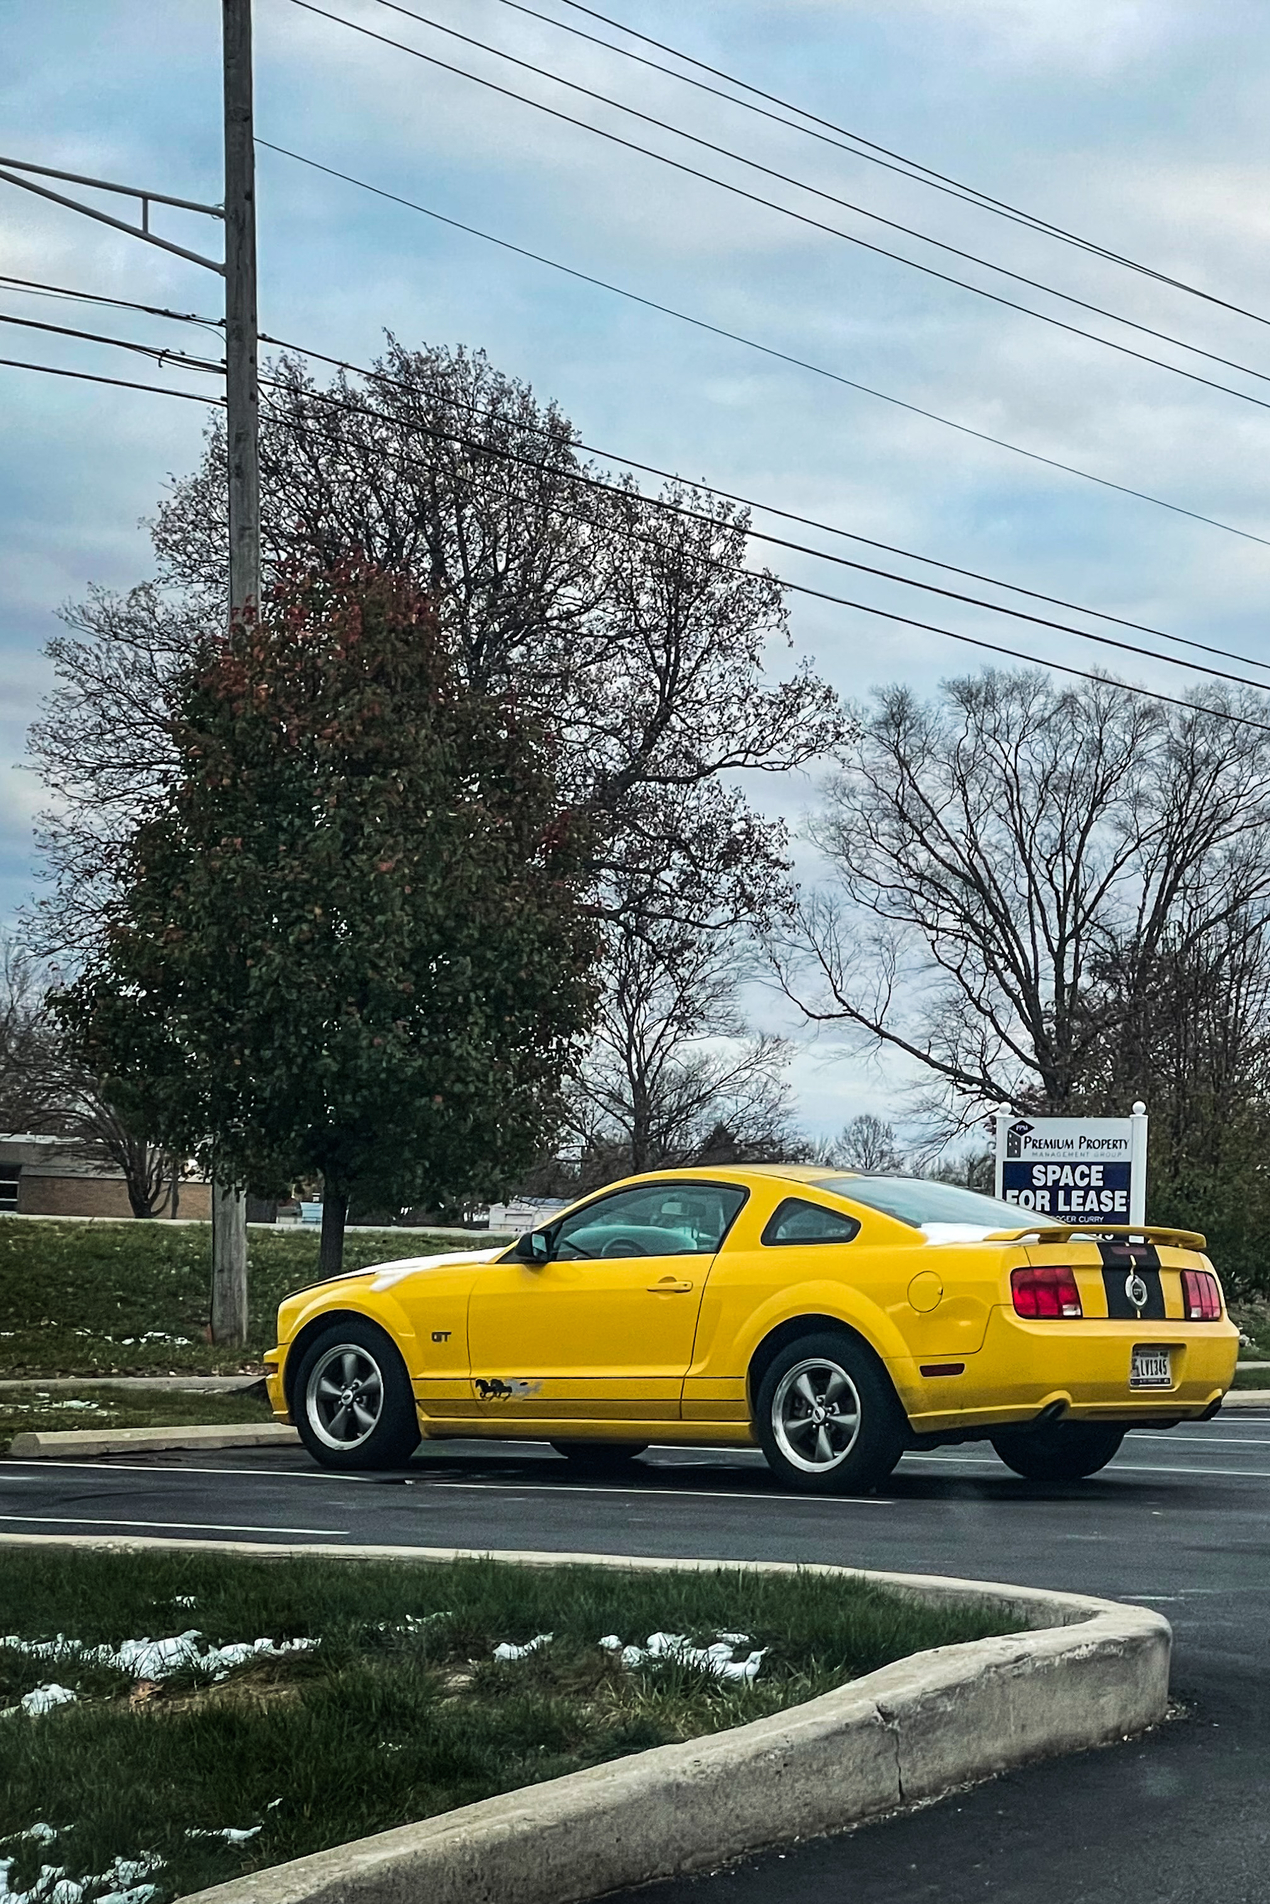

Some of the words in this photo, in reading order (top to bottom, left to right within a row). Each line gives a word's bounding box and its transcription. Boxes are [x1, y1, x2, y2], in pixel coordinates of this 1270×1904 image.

[1031, 1164, 1104, 1187] SPACE
[1006, 1189, 1051, 1212] FOR
[1057, 1189, 1128, 1212] LEASE
[1053, 1215, 1077, 1223] OGER
[1078, 1214, 1105, 1224] CURRY
[431, 1331, 452, 1343] GT
